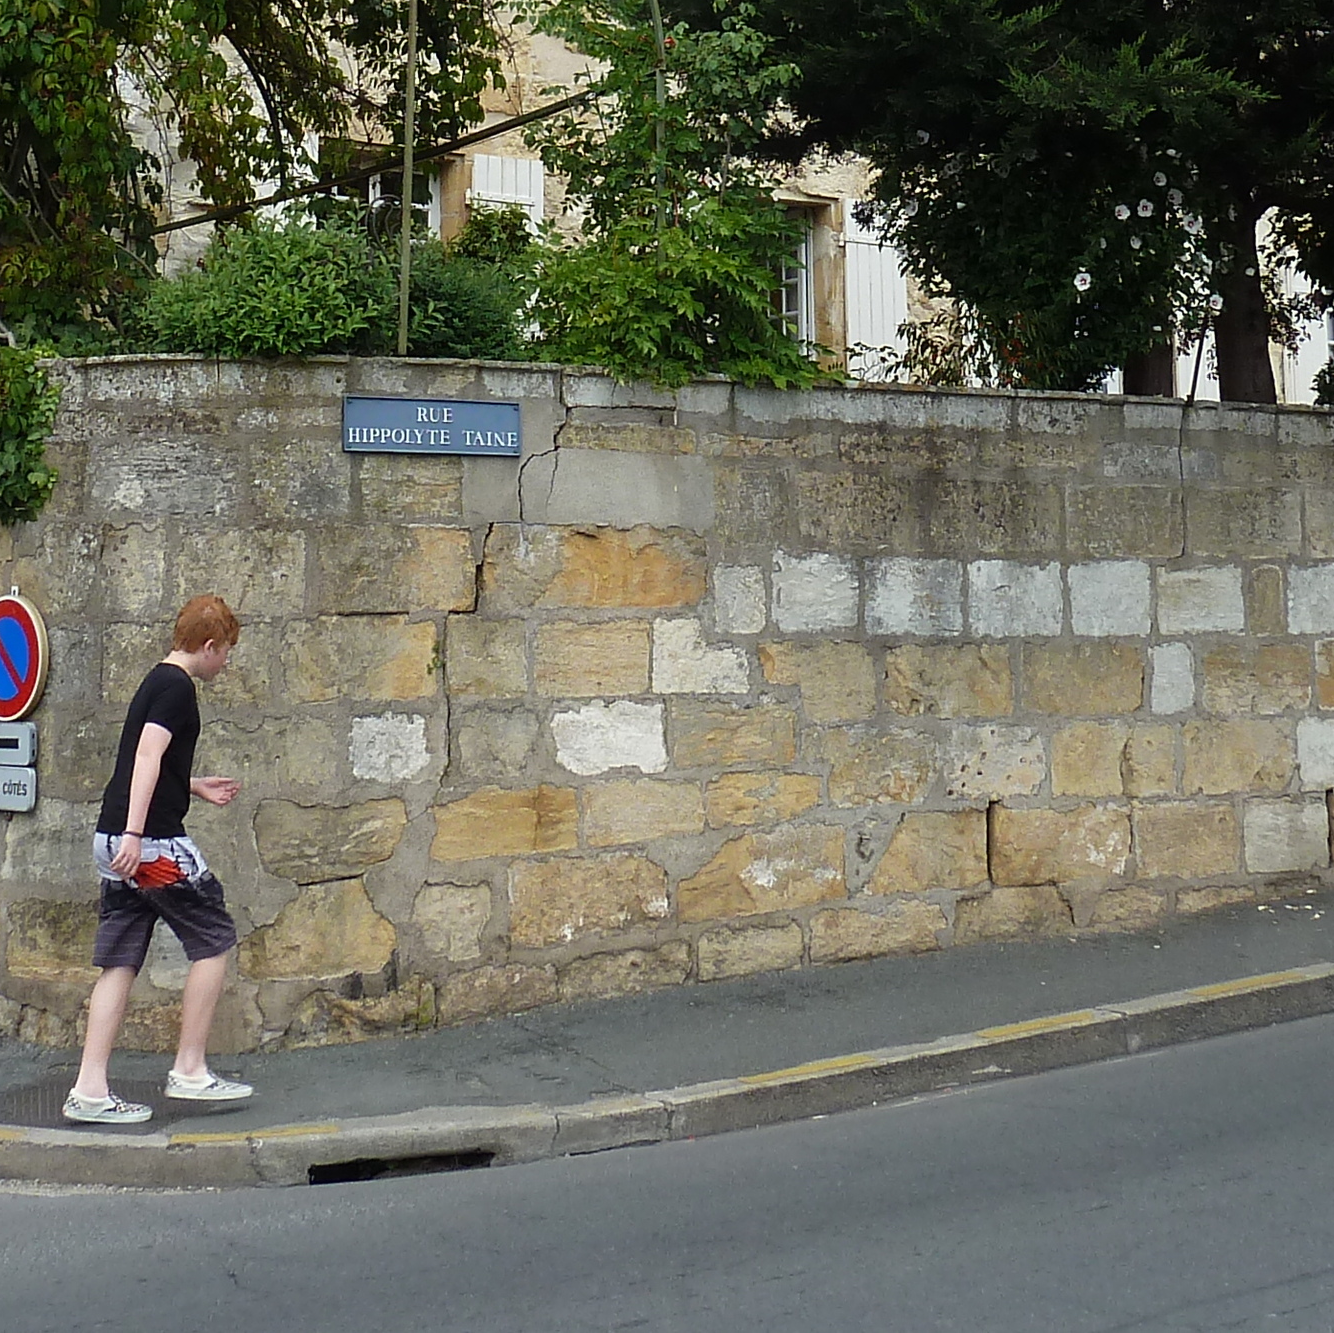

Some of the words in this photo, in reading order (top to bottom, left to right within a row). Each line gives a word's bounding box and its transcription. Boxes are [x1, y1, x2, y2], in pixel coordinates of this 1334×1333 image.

[416, 406, 454, 423] RUE
[348, 427, 451, 446] HIPPOLYTE
[462, 429, 518, 448] TAINE
